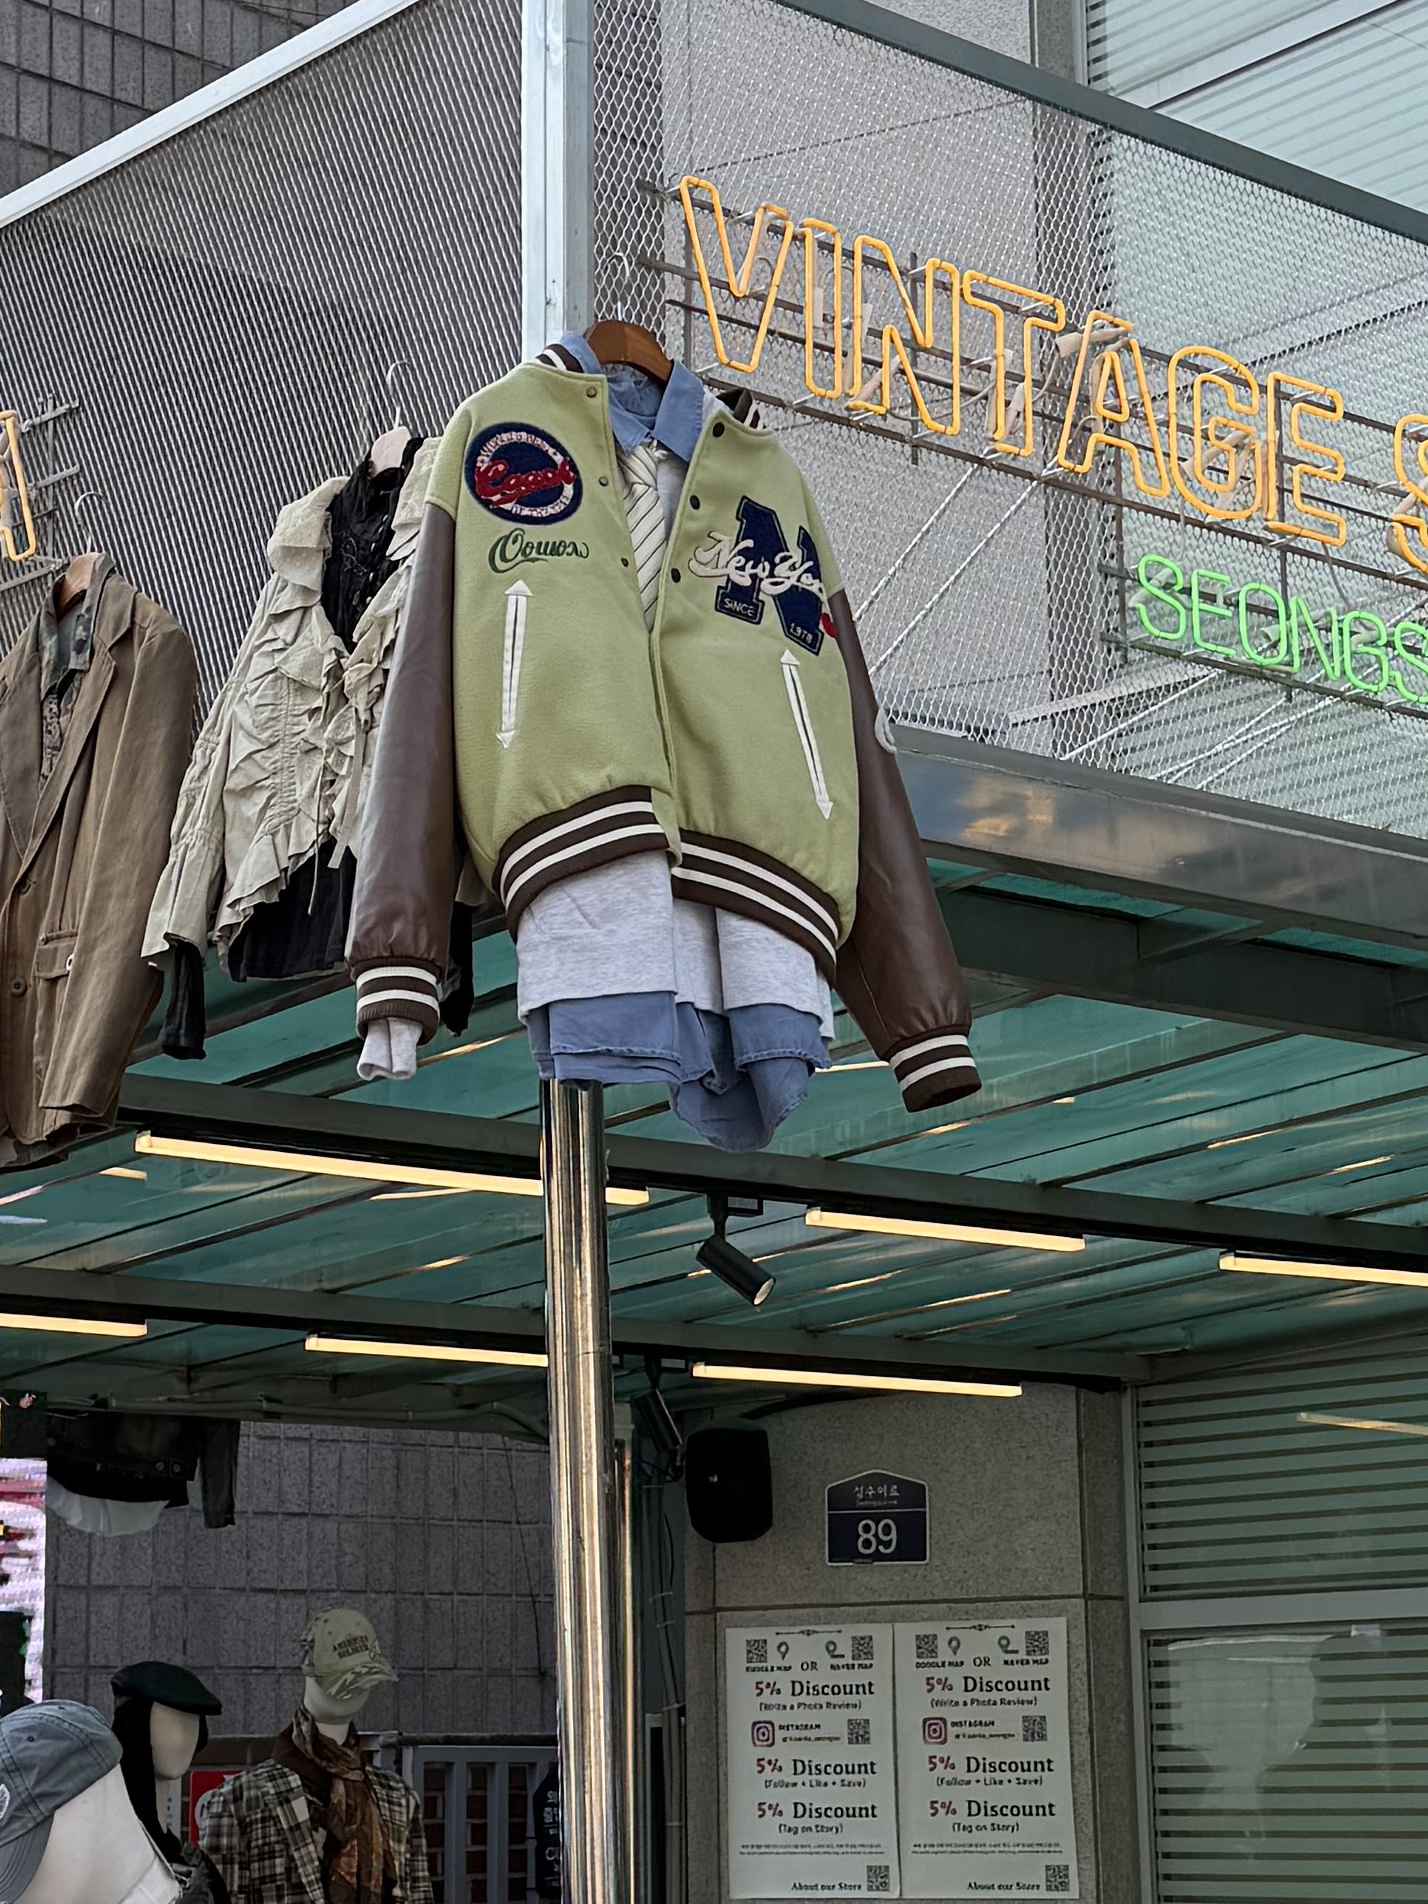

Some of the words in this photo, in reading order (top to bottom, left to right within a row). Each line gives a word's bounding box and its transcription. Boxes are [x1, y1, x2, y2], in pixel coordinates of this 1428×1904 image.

[678, 174, 1348, 548] VINTAGE
[857, 1518, 897, 1554] 89
[800, 1661, 818, 1671] OR
[973, 1656, 991, 1667] OR
[755, 1681, 781, 1696] 5%
[791, 1680, 875, 1696] Discount
[925, 1676, 953, 1693] 5%
[963, 1675, 1051, 1693] Discount
[756, 1758, 782, 1774] 5%
[792, 1759, 877, 1775] Discount
[928, 1755, 956, 1772] 5%
[966, 1756, 1054, 1773] Discount
[757, 1802, 783, 1818] 5%
[793, 1802, 878, 1818] Discount
[929, 1800, 957, 1817] 5%
[967, 1800, 1056, 1817] Discount
